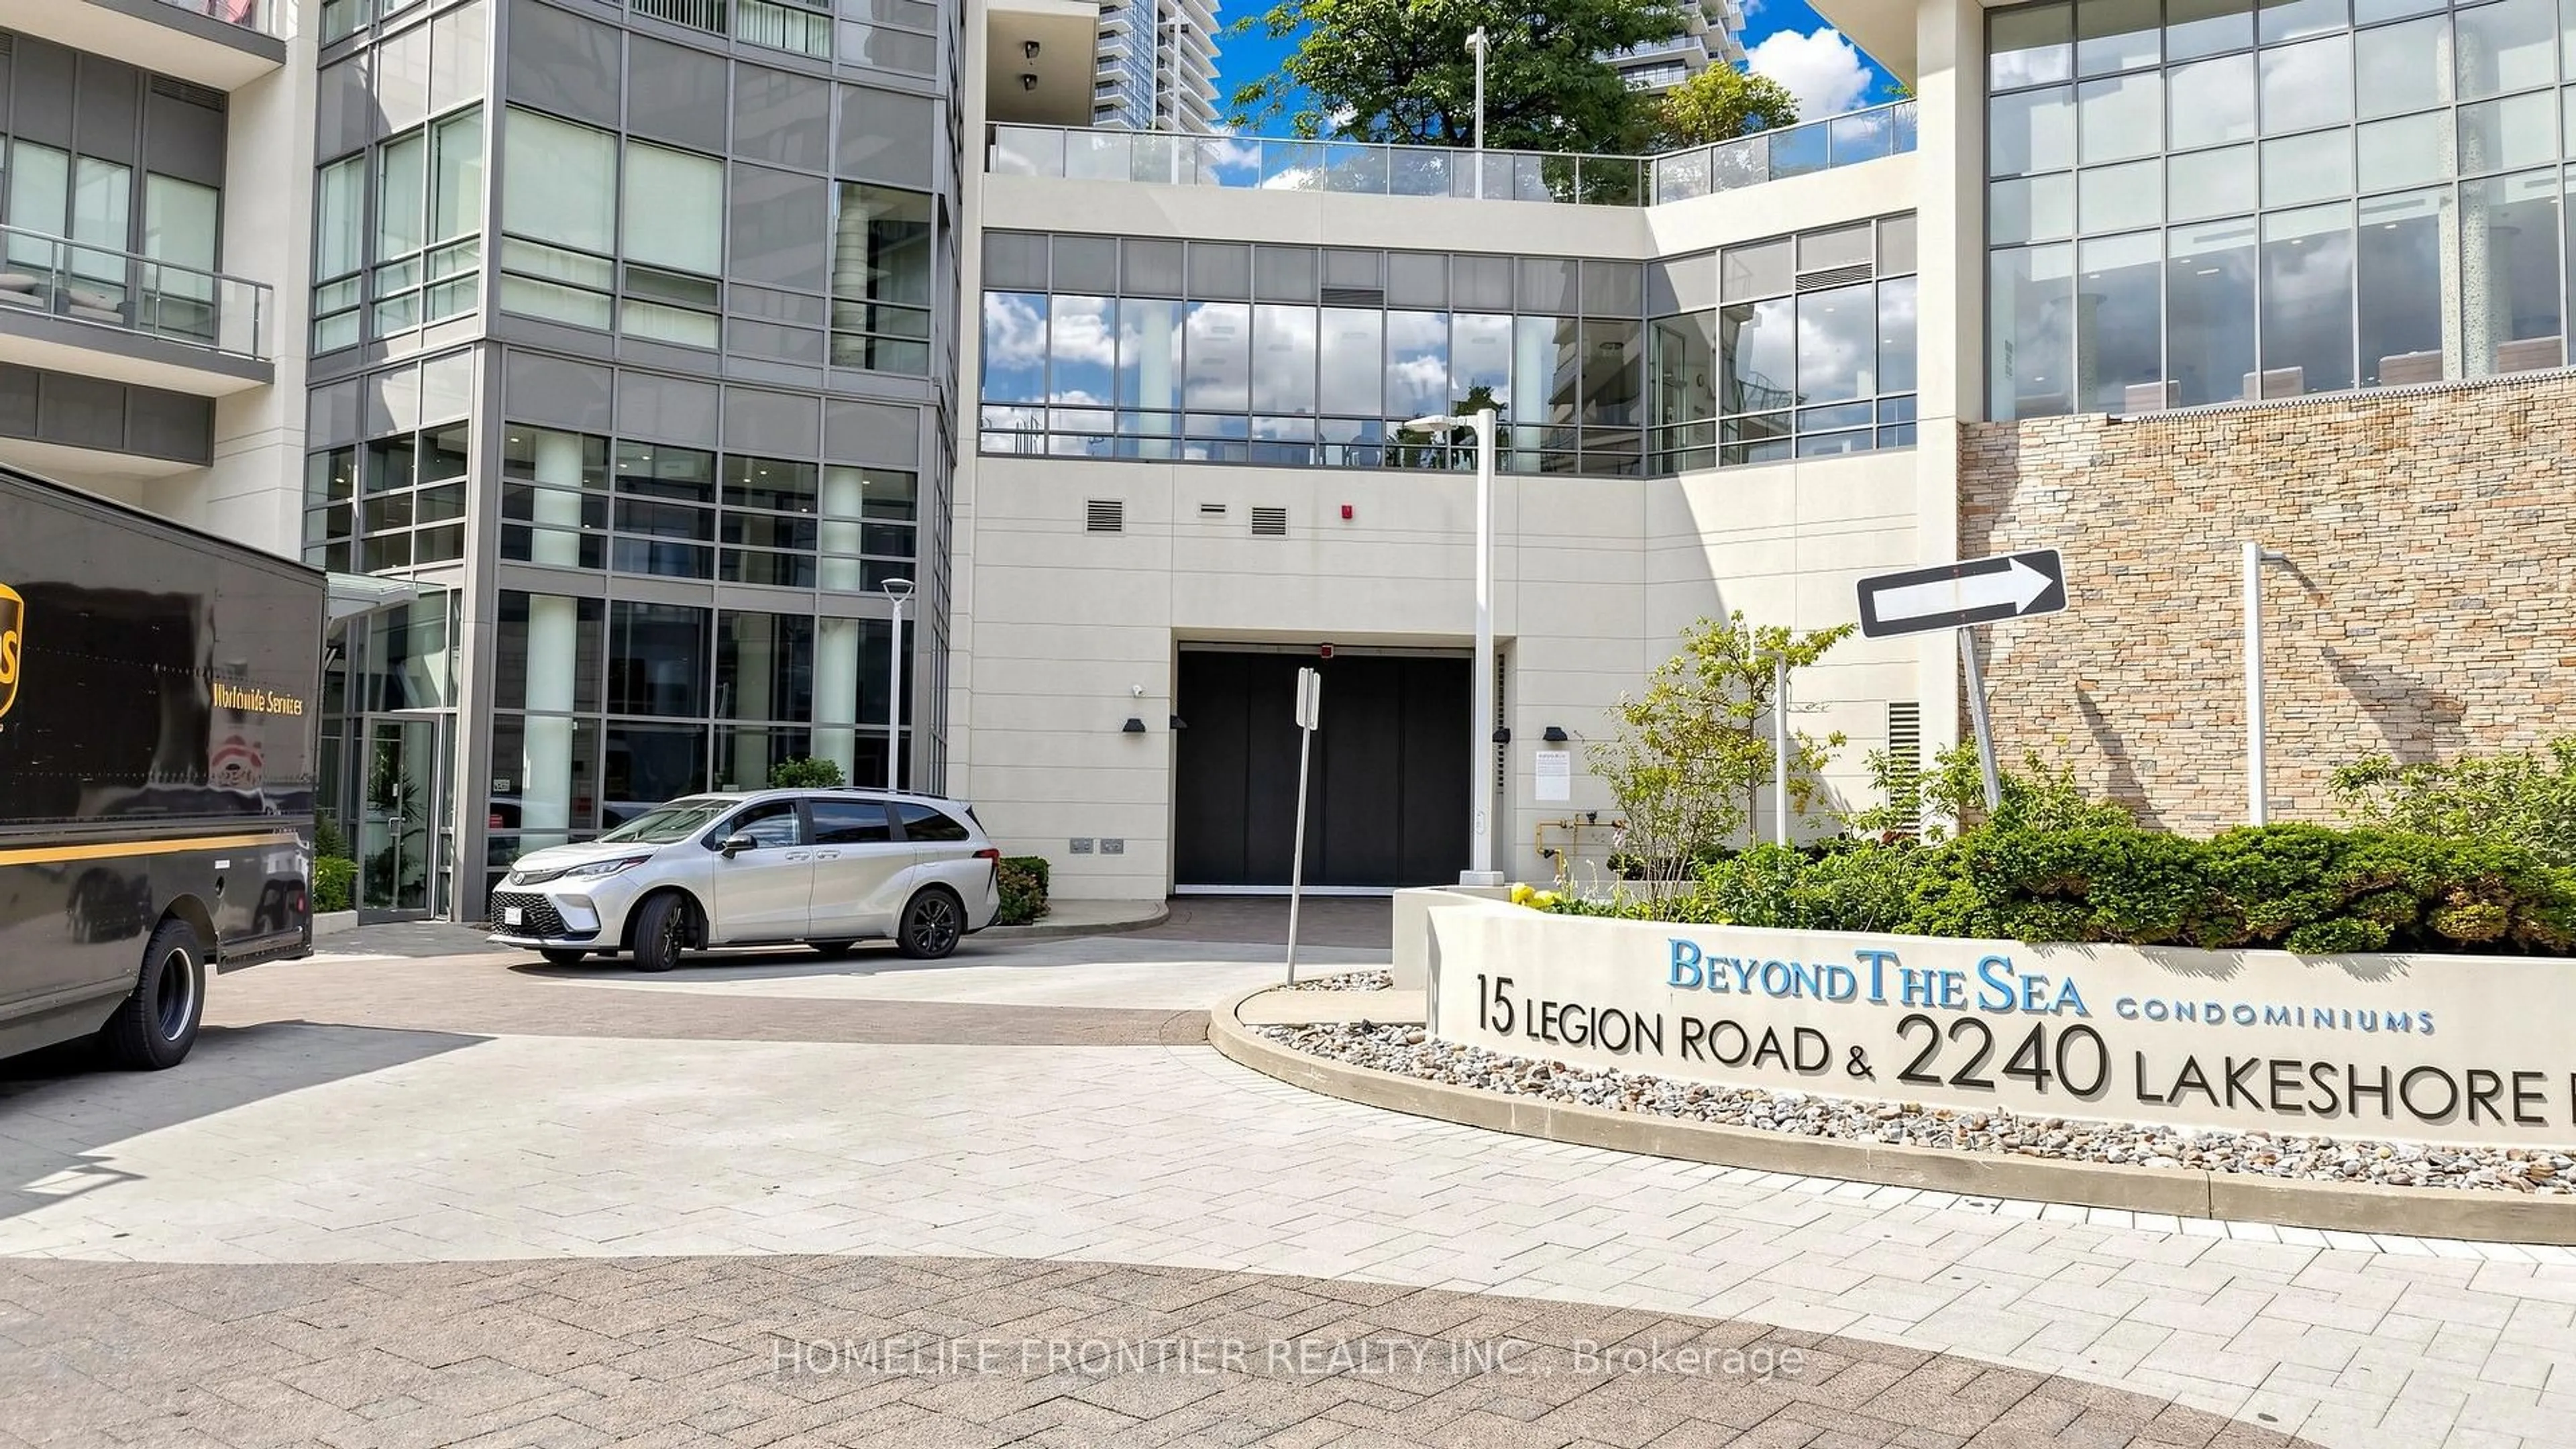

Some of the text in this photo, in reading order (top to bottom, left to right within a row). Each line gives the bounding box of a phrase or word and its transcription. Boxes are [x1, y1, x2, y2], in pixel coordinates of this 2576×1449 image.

[1477, 973, 1515, 1033] 15
[1526, 998, 1664, 1056] LEGION
[1680, 1016, 1831, 1071] ROAD
[1845, 1044, 1875, 1078] &
[1896, 1014, 2107, 1096] 2240
[2135, 1050, 2545, 1123] LAKESHORE
[2116, 997, 2435, 1035] CONDOMINIUMS
